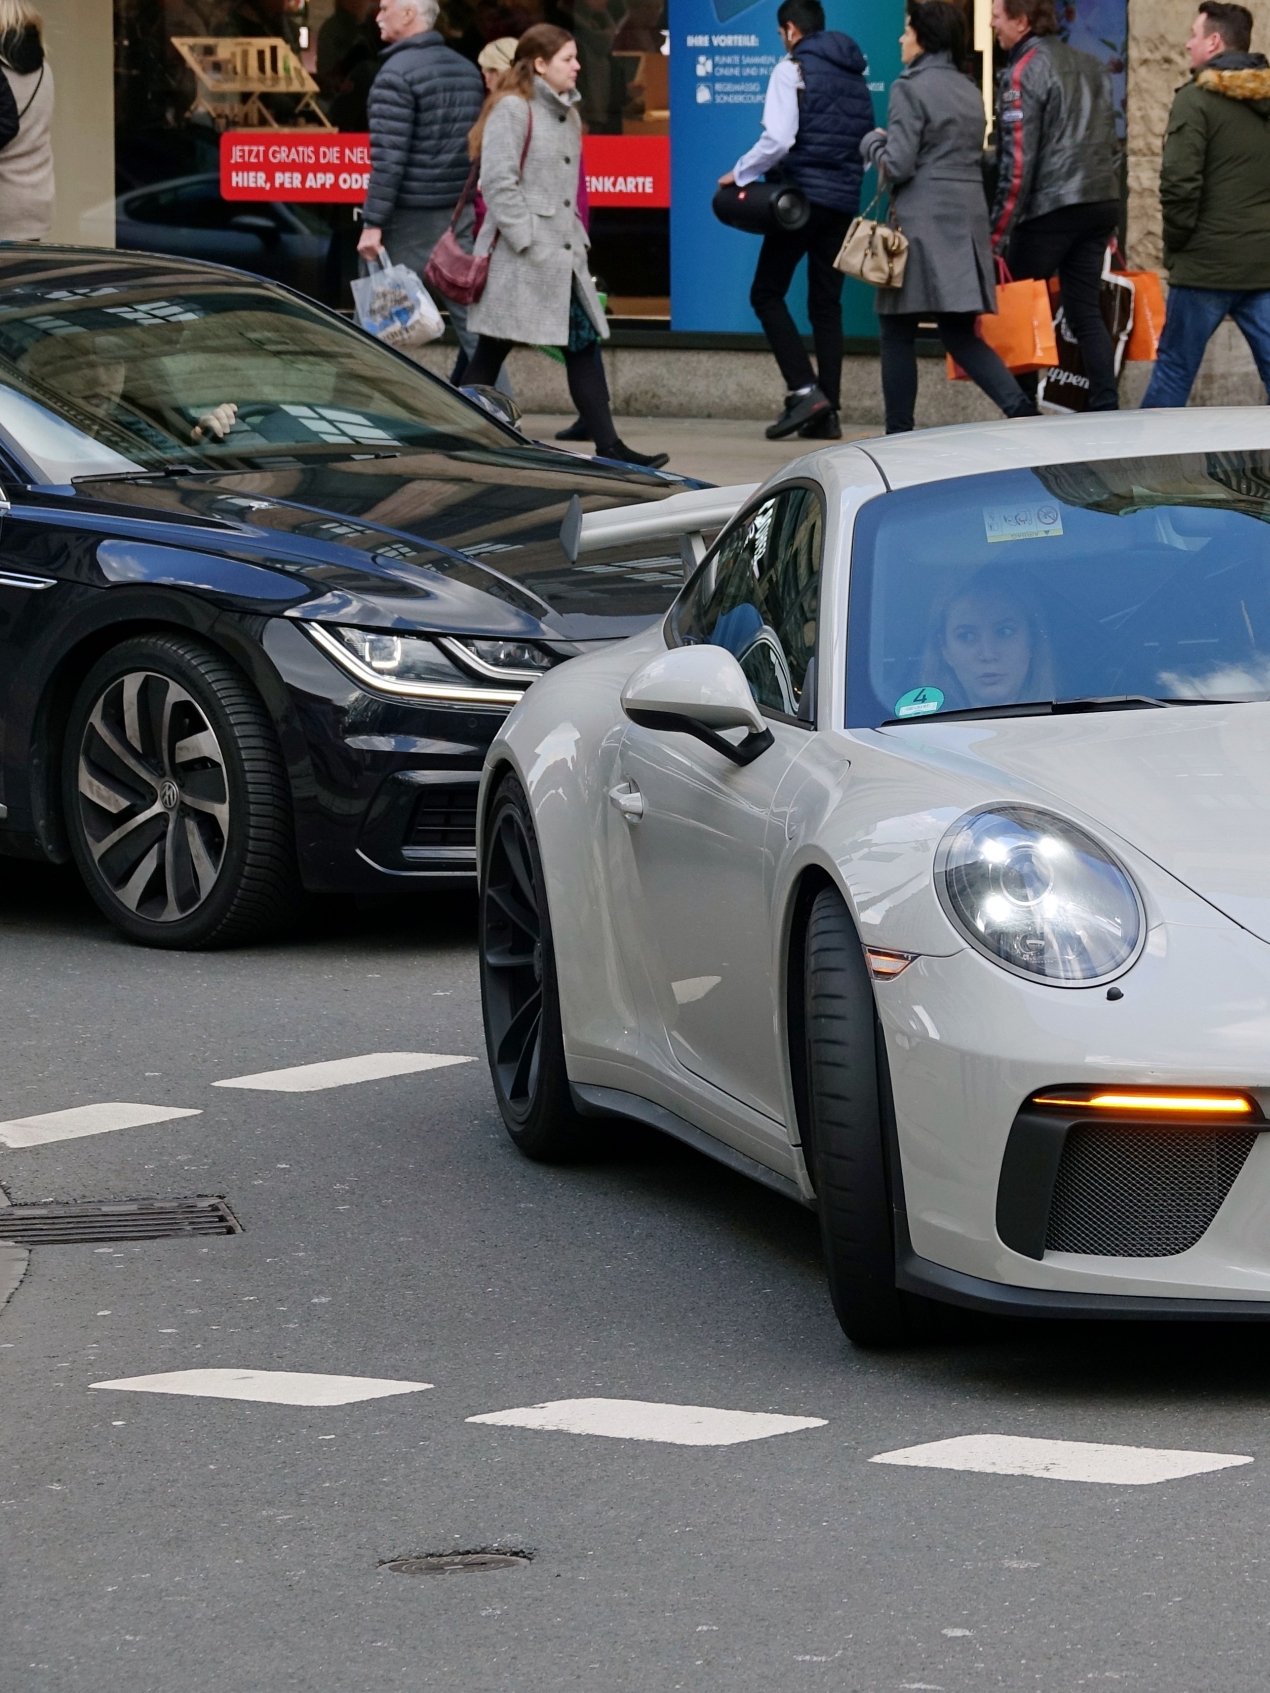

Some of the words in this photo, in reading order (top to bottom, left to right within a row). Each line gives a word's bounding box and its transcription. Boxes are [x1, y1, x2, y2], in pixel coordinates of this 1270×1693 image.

[687, 35, 709, 47] IHRE
[230, 145, 265, 164] JETZT
[268, 145, 315, 164] GRATIS
[319, 146, 341, 164] DIE
[231, 170, 271, 190] HIER,
[274, 171, 302, 189] PER
[305, 171, 335, 189] APP
[913, 688, 927, 704] 4
